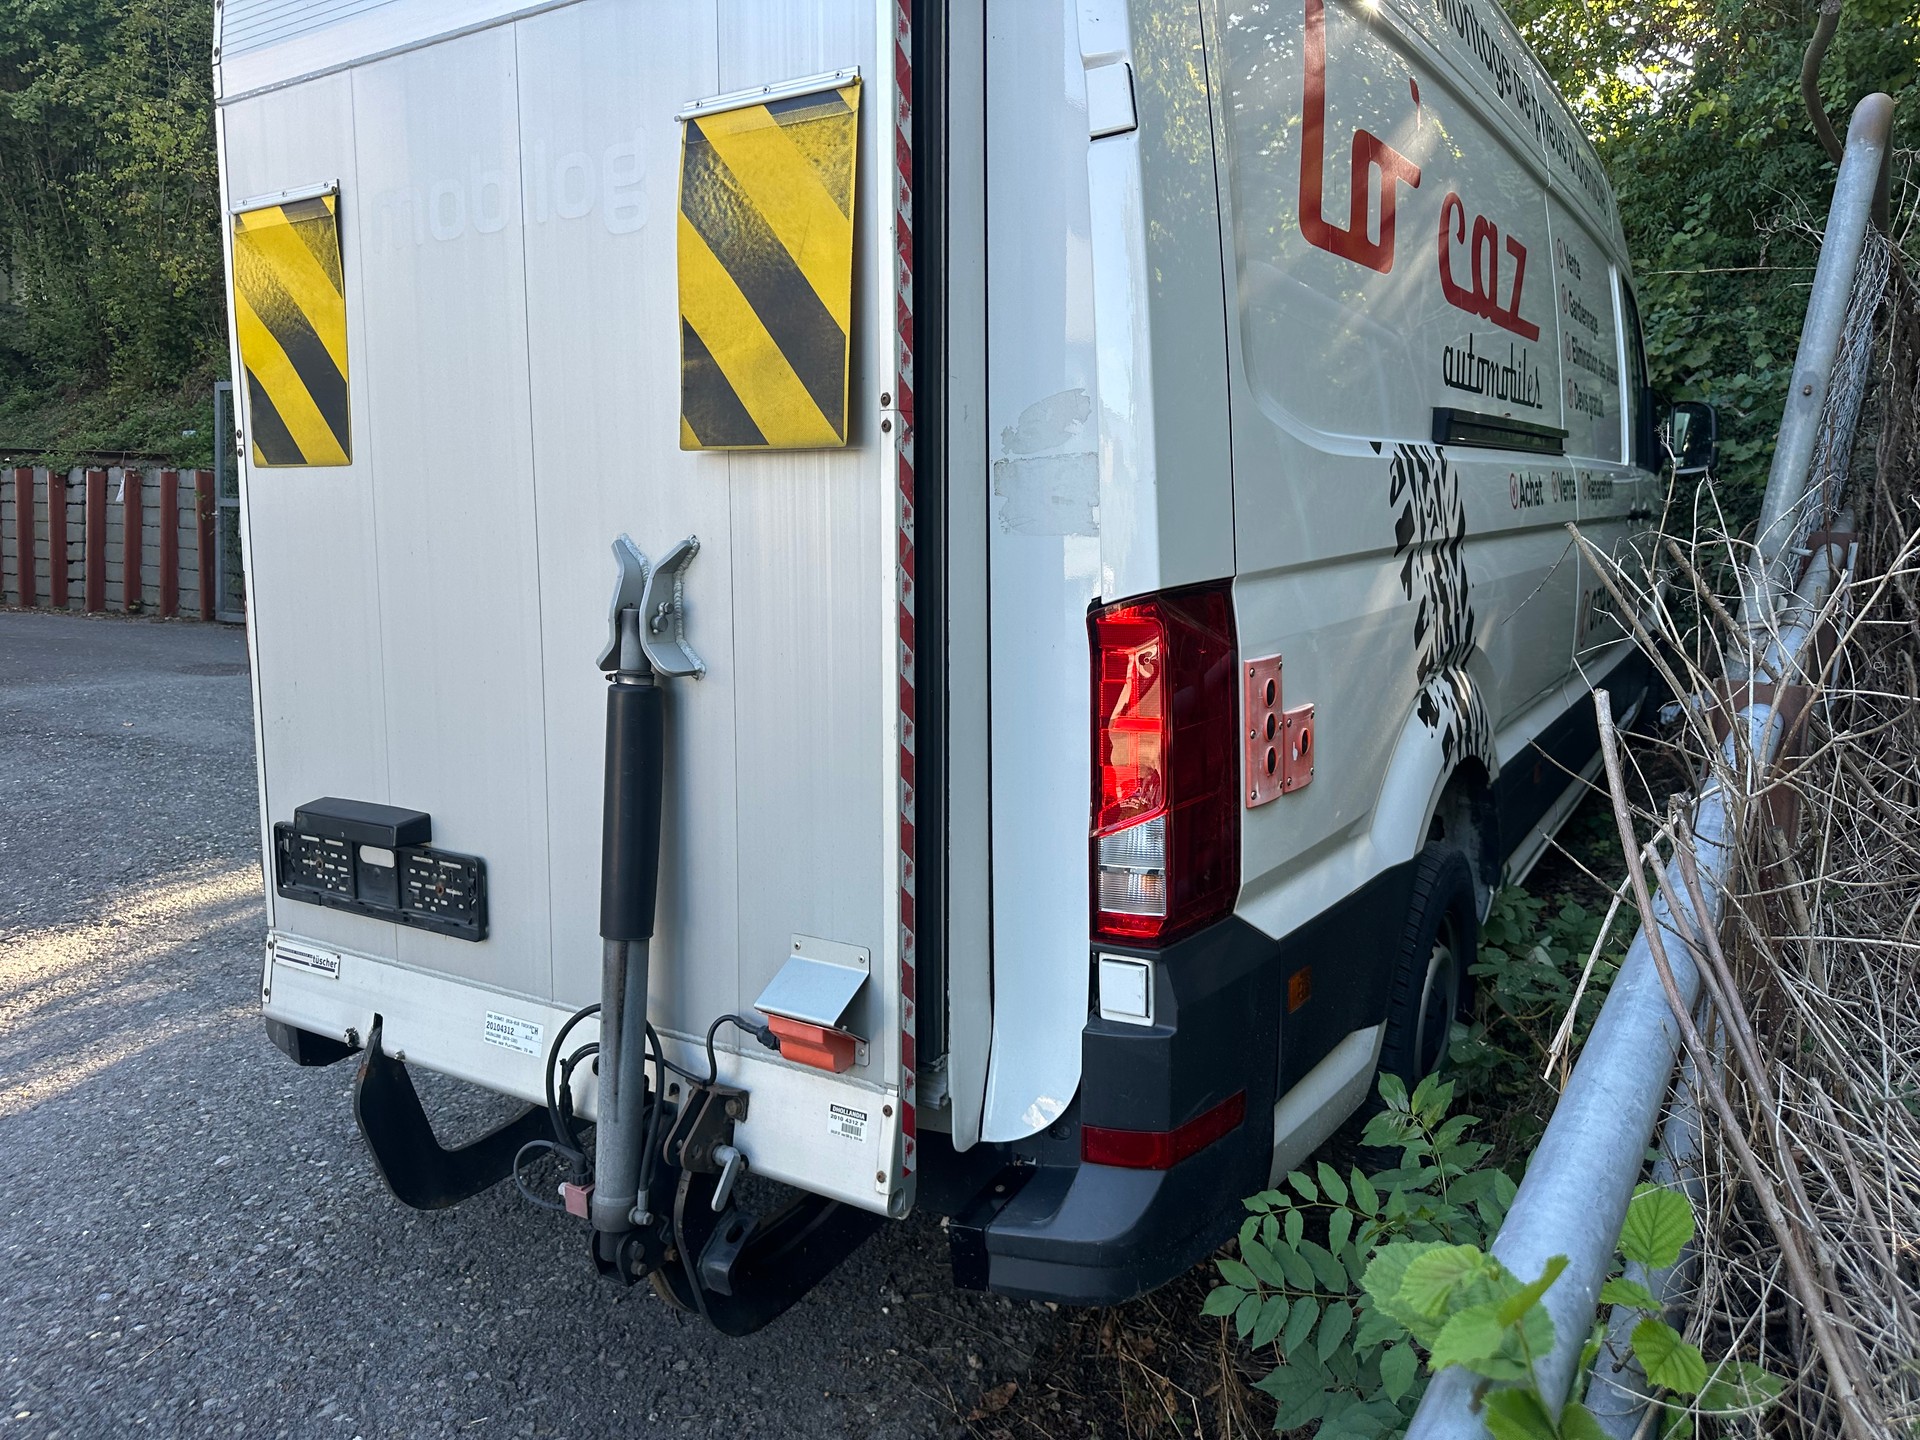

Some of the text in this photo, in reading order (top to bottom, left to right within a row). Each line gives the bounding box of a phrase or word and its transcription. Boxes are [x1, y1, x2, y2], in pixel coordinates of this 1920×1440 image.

[1513, 58, 1531, 120] de
[1562, 241, 1582, 281] Vente
[1442, 332, 1543, 410] automobiles
[1519, 471, 1545, 509] Achat
[312, 954, 338, 969] tüscher
[486, 1020, 515, 1036] 20104312
[830, 1113, 844, 1122] 2010
[845, 1117, 859, 1126] 4312
[832, 1105, 866, 1120] DHOLLANDIA
